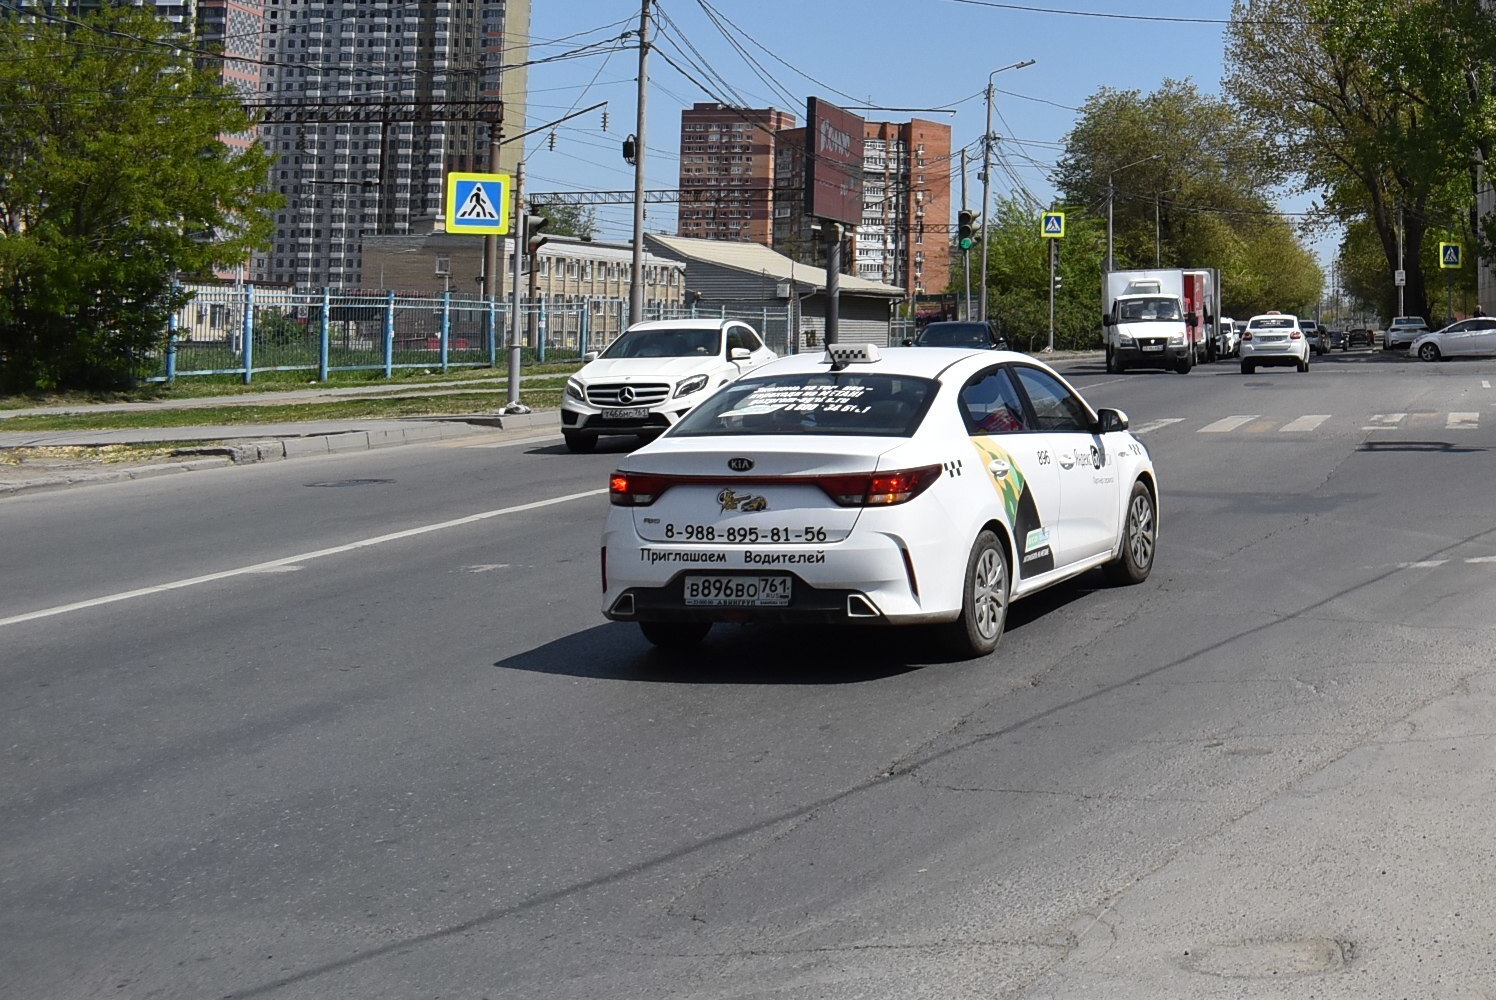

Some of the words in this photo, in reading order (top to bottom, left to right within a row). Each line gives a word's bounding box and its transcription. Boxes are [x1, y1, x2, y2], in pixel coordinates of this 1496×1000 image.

[731, 460, 750, 470] KIA
[665, 524, 827, 543] 8-988-895-81-56
[640, 548, 727, 564] Приглашаем
[744, 550, 826, 564] Водителей
[690, 579, 758, 599] В896ВО
[760, 578, 788, 594] 761
